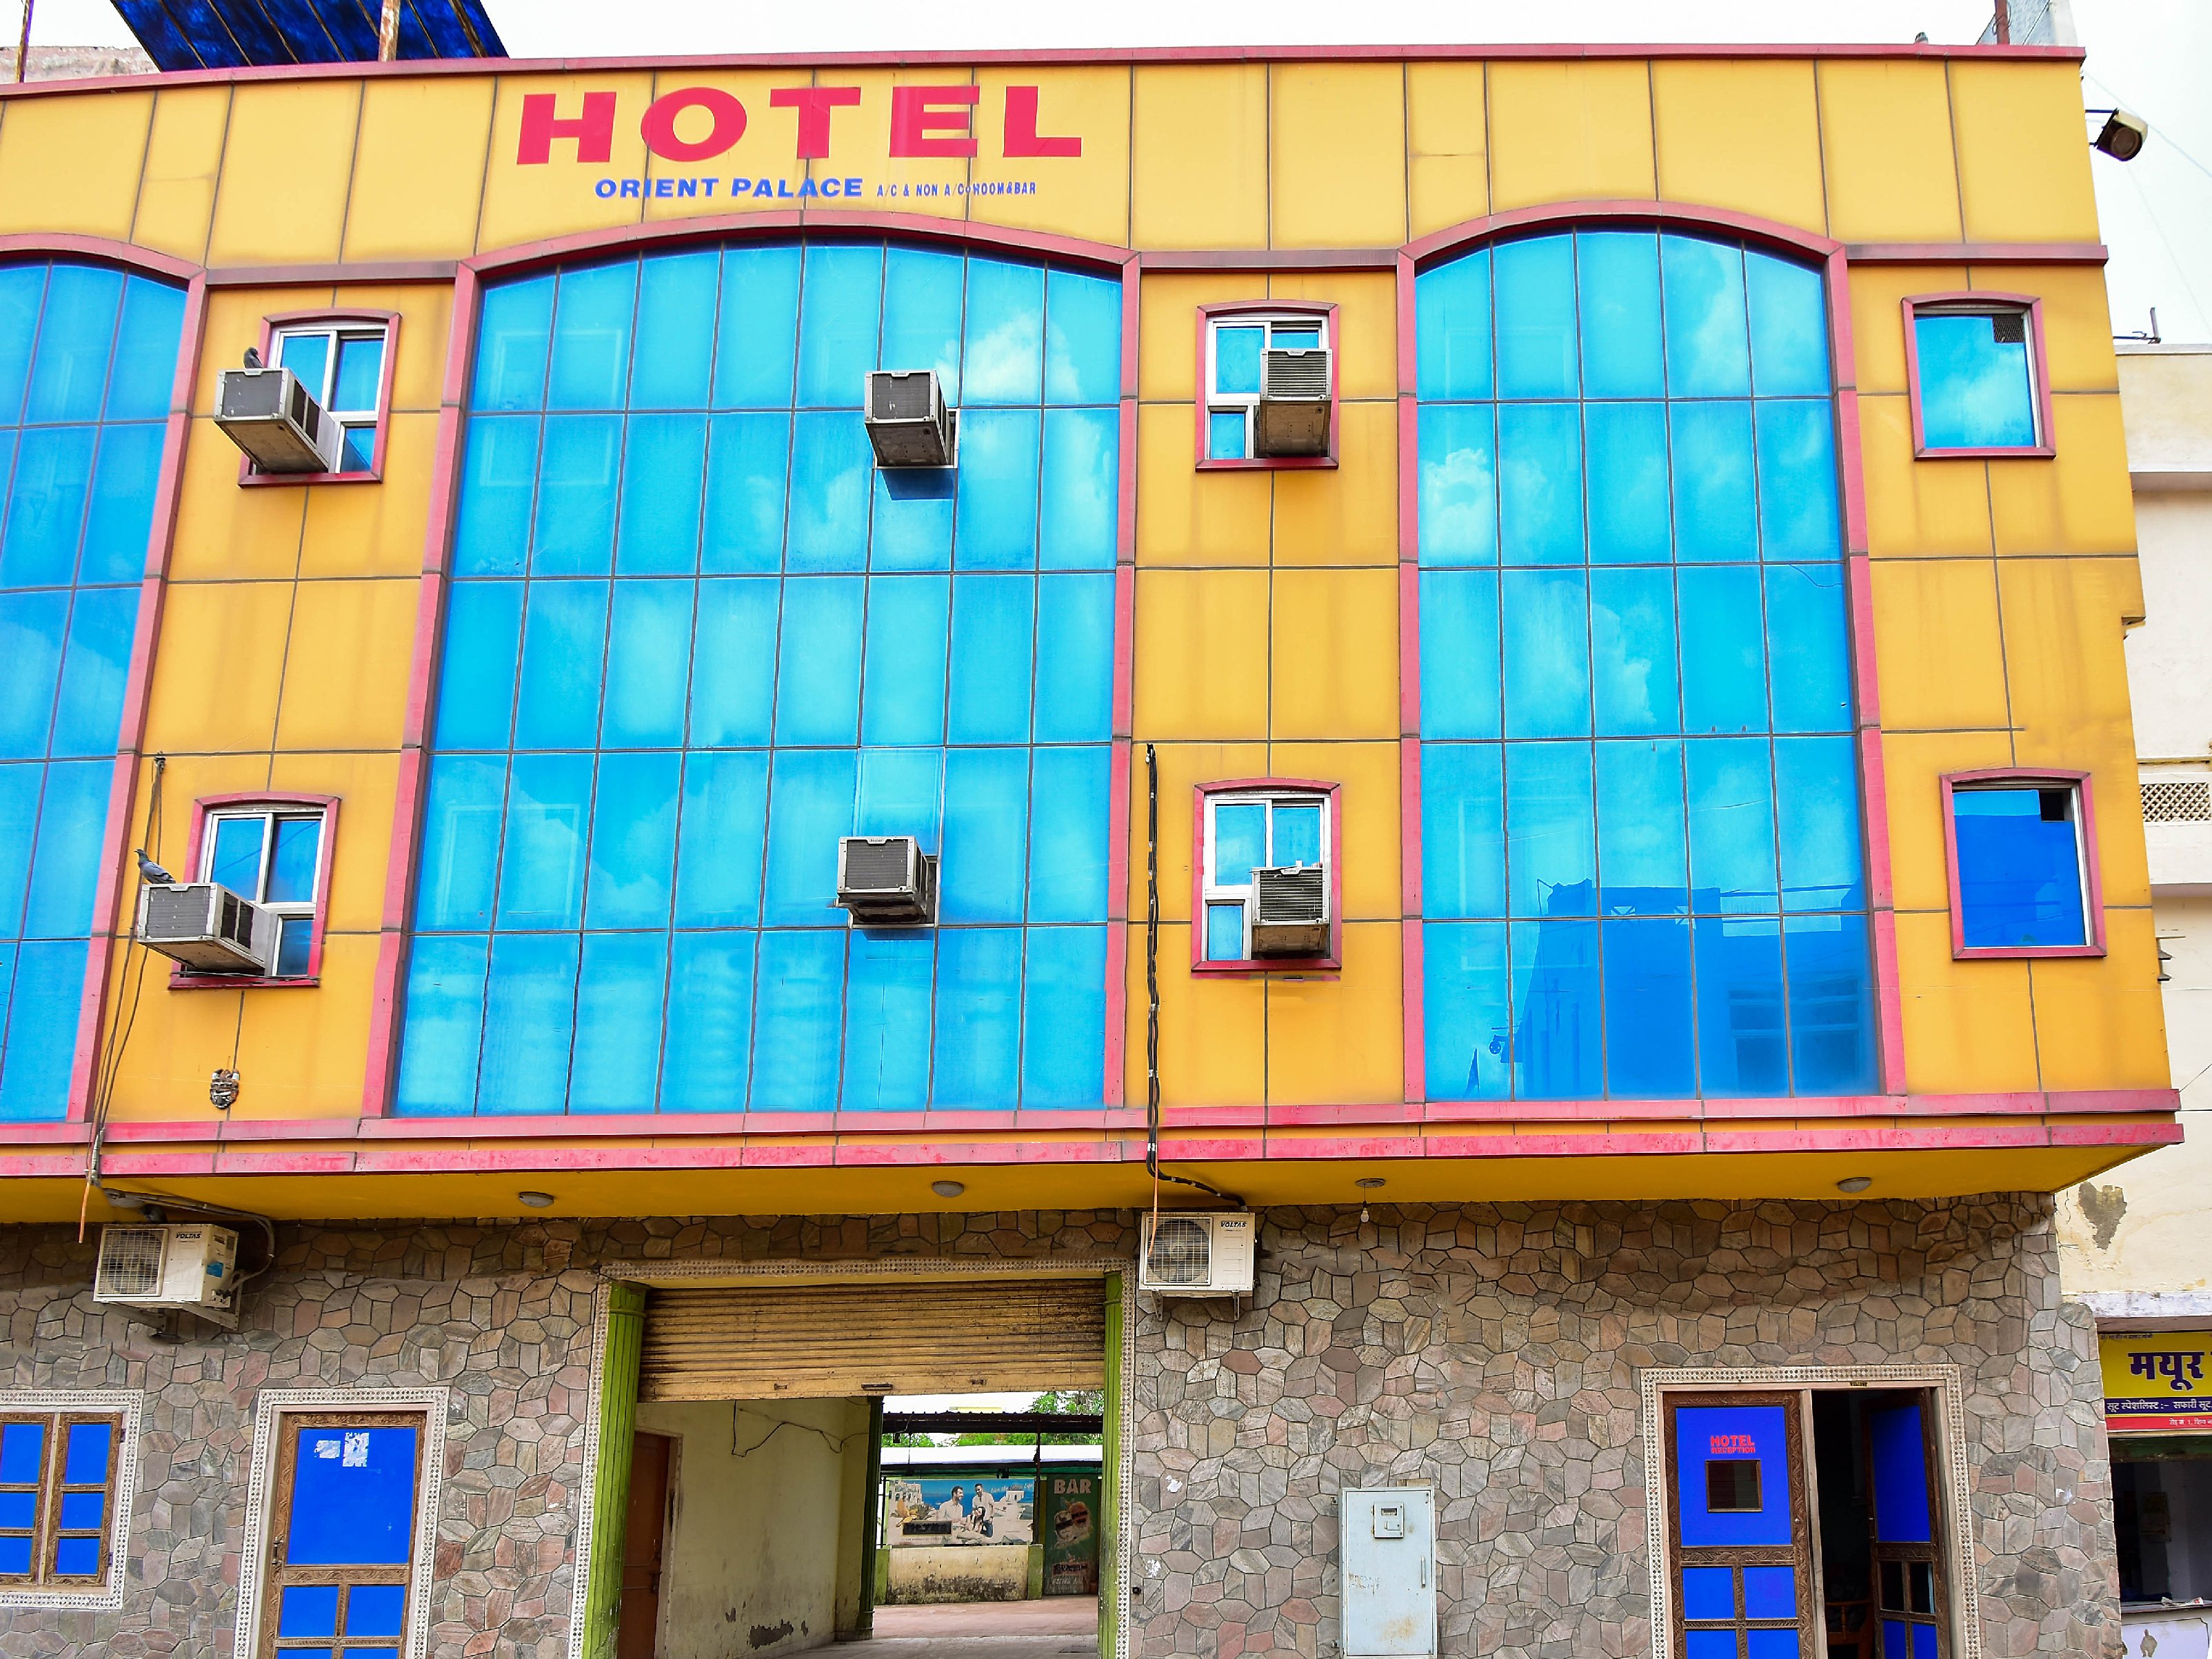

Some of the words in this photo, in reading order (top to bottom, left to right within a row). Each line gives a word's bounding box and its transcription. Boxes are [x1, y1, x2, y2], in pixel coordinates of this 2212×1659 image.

[516, 86, 1081, 165] HOTEL
[594, 178, 719, 199] ORIENT
[731, 178, 863, 198] PALACE
[877, 183, 897, 197] A/C
[903, 183, 909, 197] &
[916, 183, 938, 197] NON
[2127, 1351, 2205, 1391] मयूर
[2107, 1402, 2120, 1413] सूट
[2173, 1398, 2197, 1409] सफारी
[1710, 1435, 1755, 1447] HOTEL
[1054, 1478, 1092, 1494] BAR
